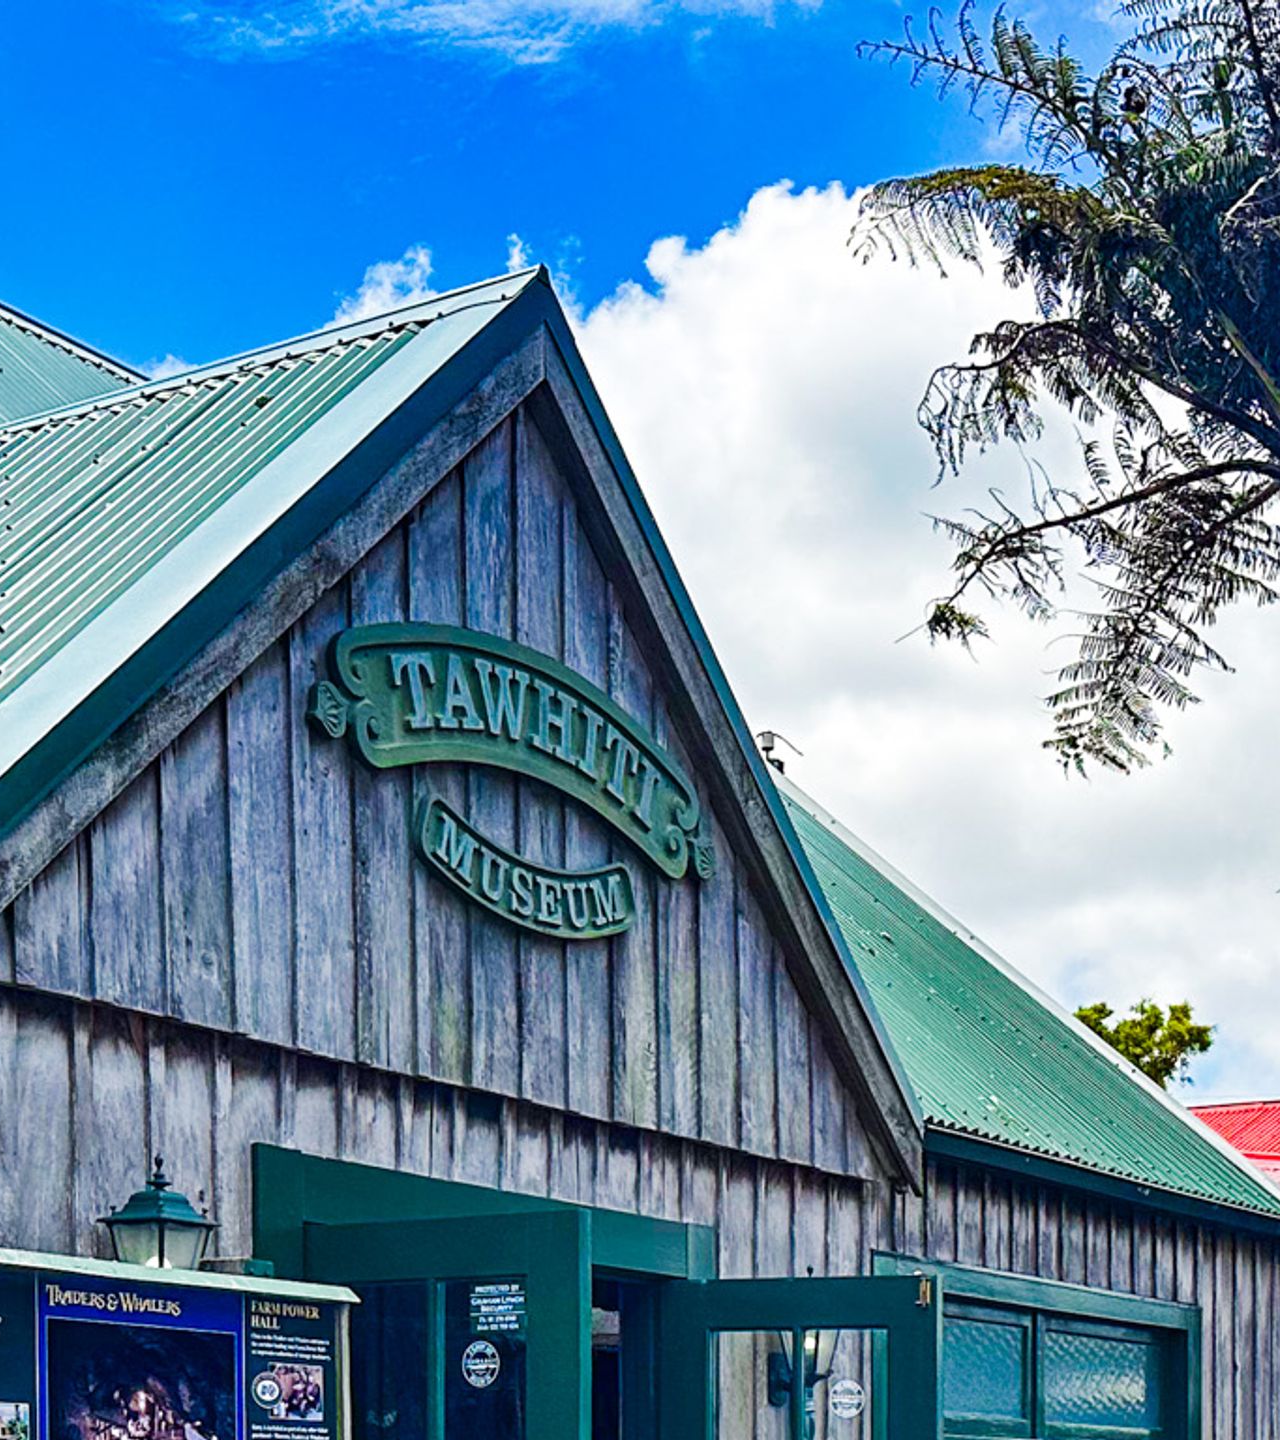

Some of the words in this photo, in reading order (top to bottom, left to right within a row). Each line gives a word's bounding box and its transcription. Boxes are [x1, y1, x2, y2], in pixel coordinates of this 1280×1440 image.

[388, 652, 662, 833] TAWHITI
[430, 811, 628, 928] MUSEUM
[107, 1293, 118, 1312] &
[251, 1300, 281, 1316] FARM
[282, 1303, 320, 1320] POWER
[251, 1315, 280, 1330] HALL
